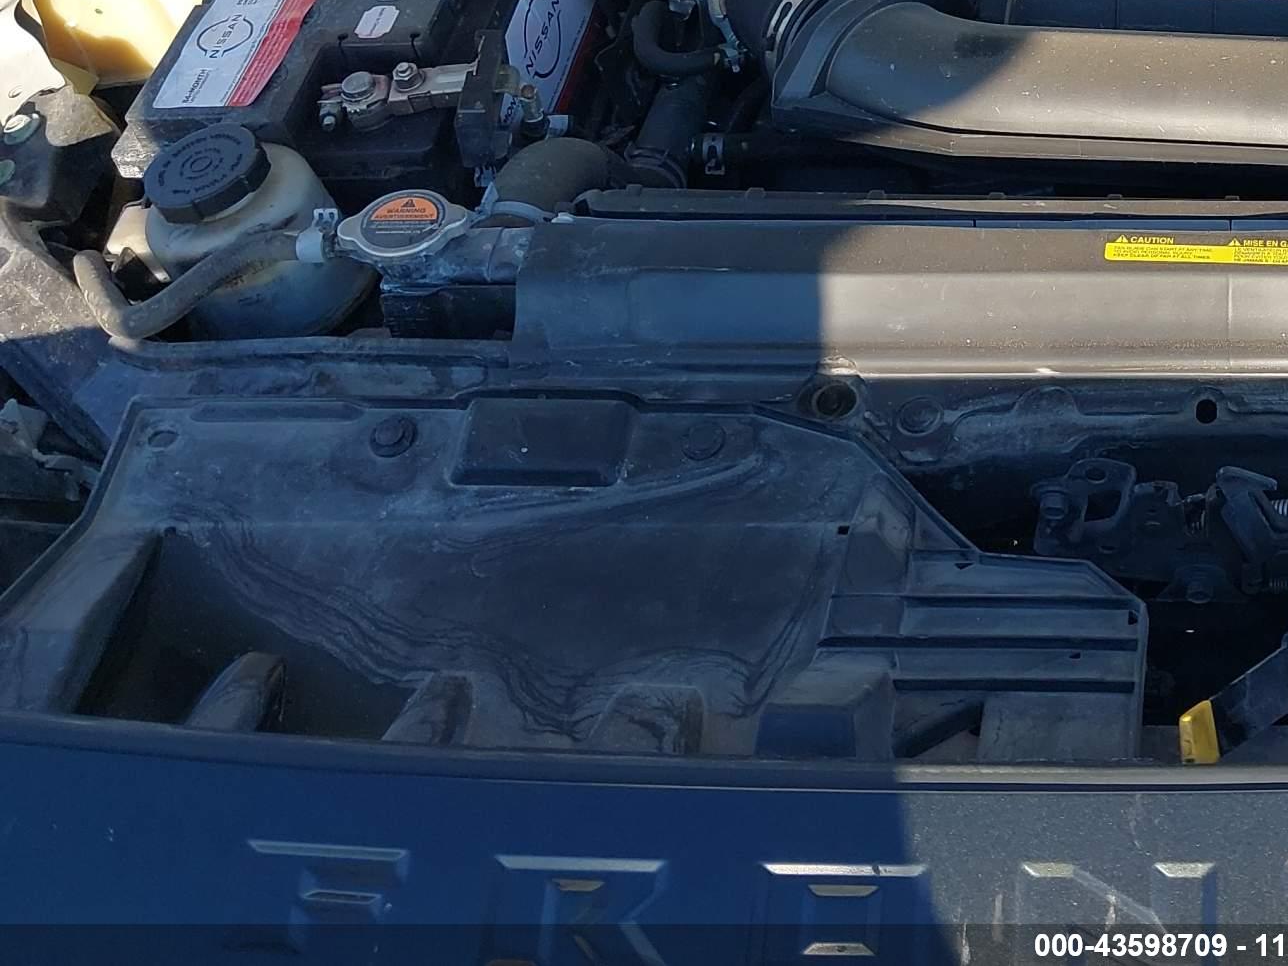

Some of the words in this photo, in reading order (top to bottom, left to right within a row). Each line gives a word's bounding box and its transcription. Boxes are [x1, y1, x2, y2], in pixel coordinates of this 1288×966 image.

[208, 13, 243, 59] NISSAN
[1130, 236, 1175, 244] CAUTION
[1243, 239, 1264, 247] MISE
